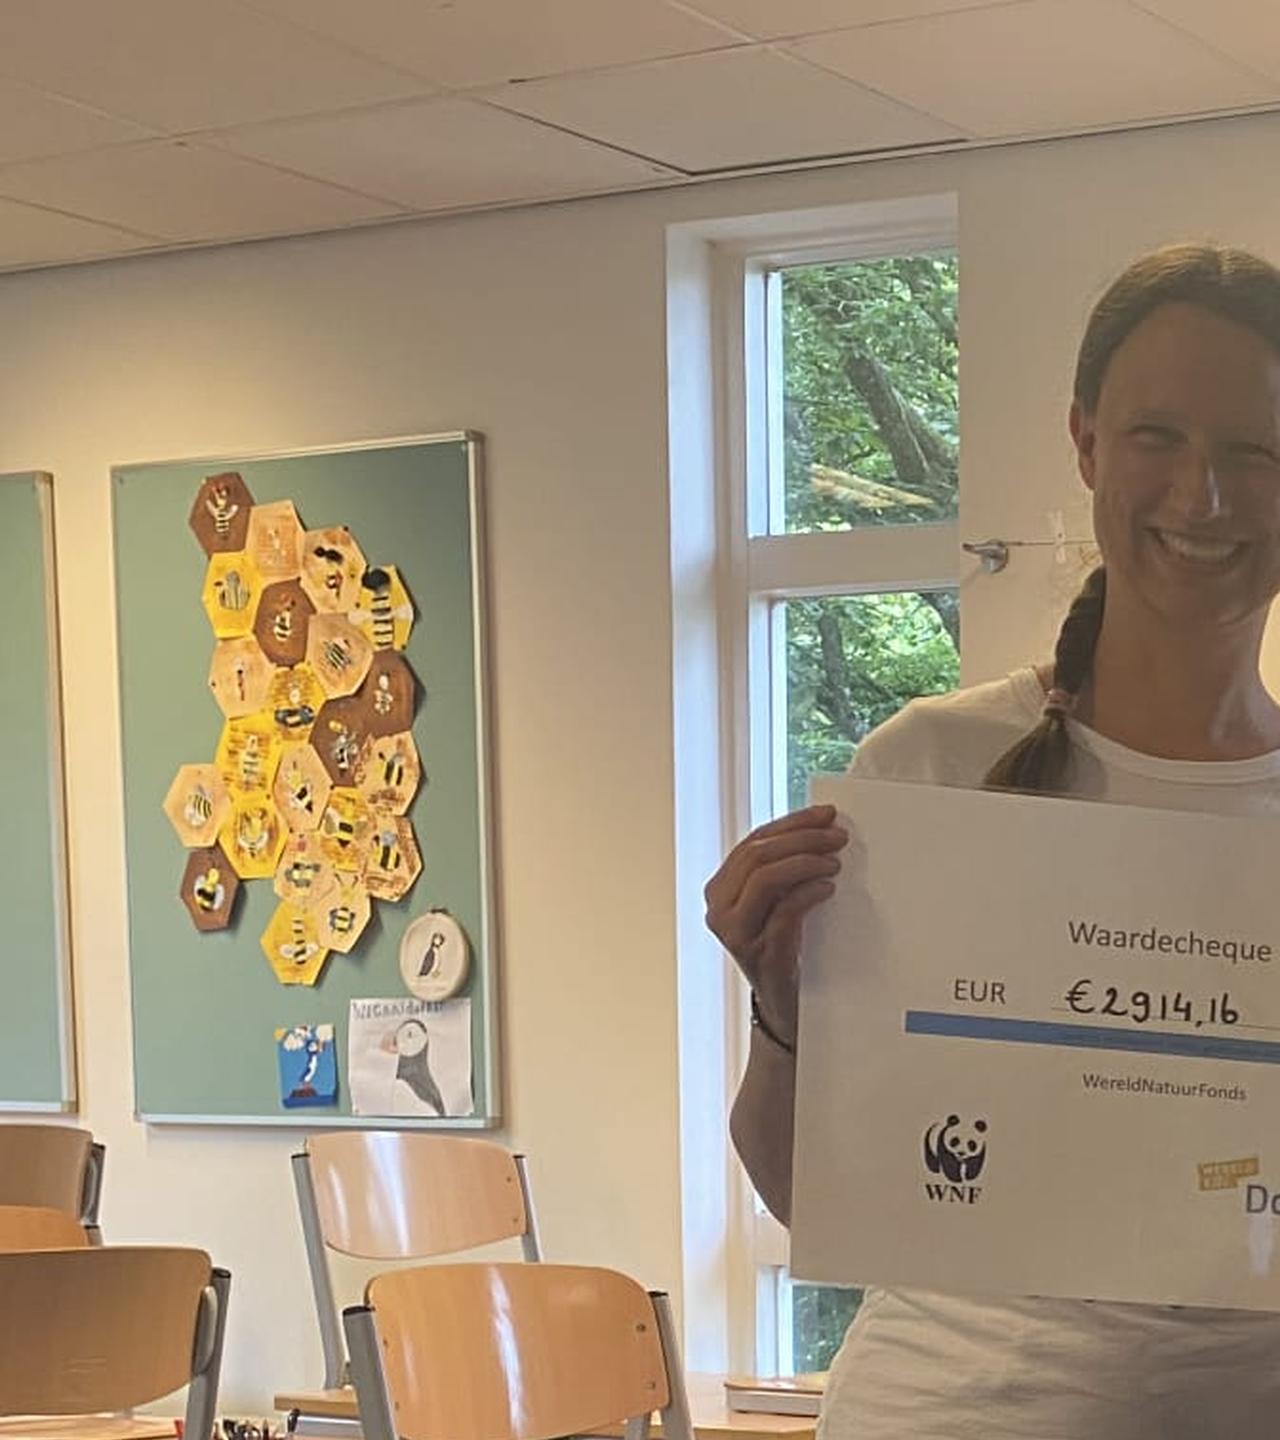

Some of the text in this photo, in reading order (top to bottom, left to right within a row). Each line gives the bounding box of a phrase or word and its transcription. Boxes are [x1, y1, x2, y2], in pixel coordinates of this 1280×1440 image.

[1069, 921, 1272, 964] Waardecheque
[954, 979, 1006, 1004] EUR
[1082, 1073, 1247, 1101] WereldNatuurFonds
[925, 1184, 982, 1204] WNF
